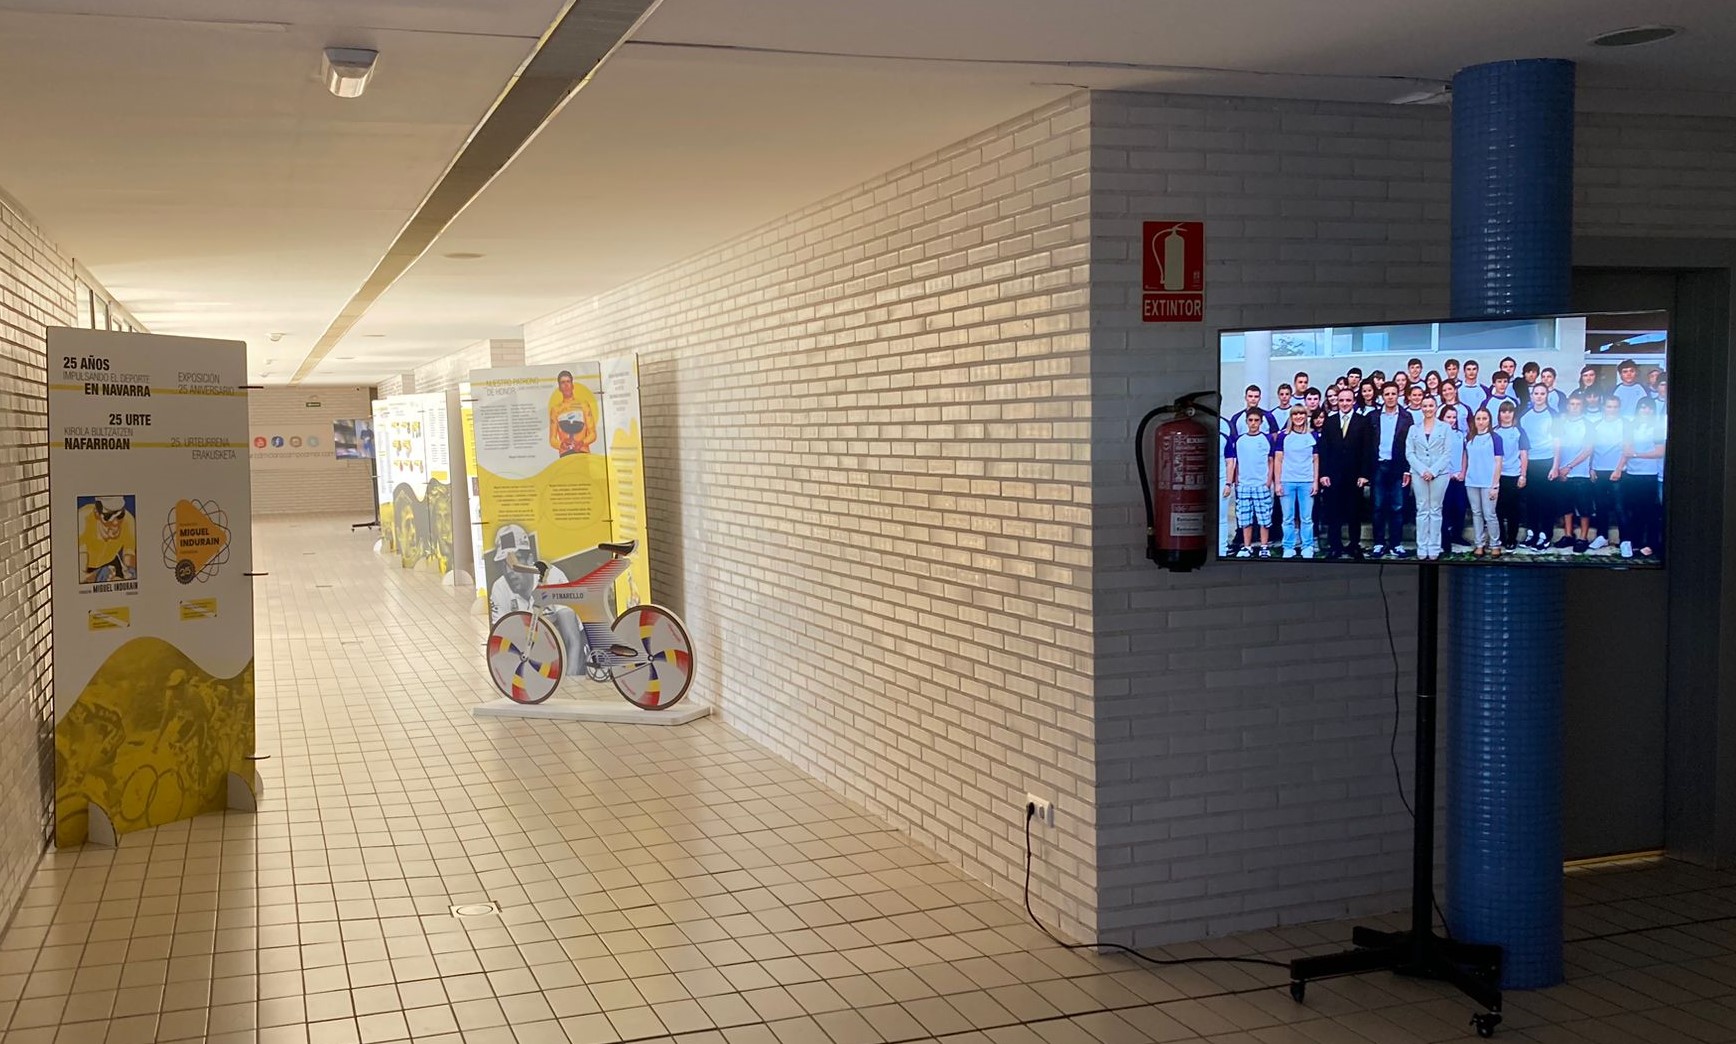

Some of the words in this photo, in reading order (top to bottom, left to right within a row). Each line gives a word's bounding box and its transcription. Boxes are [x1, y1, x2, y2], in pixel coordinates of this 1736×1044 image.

[1144, 299, 1202, 316] EXTINTOR
[63, 357, 77, 369] 25
[81, 355, 110, 371] AÑOS
[63, 371, 109, 381] IMPULSANDO
[110, 373, 119, 382] EL
[120, 374, 150, 383] DEPORTE
[84, 383, 99, 395] EN
[102, 384, 151, 397] NAVARRA
[178, 385, 189, 394] 25
[190, 385, 235, 396] ANIVERSARIO
[109, 413, 122, 426] 25
[125, 414, 151, 426] URTE
[64, 427, 90, 436] KIROLA
[91, 427, 133, 436] BULTZATZEN
[64, 437, 130, 450] NAFARROAN
[192, 449, 236, 460] ERAKUSKETA
[179, 528, 210, 537] MIGUEL
[179, 537, 220, 547] INDURAIN
[93, 584, 113, 594] MIGUEL
[114, 582, 138, 592] INDURAIN
[552, 592, 584, 600] PINARELLO
